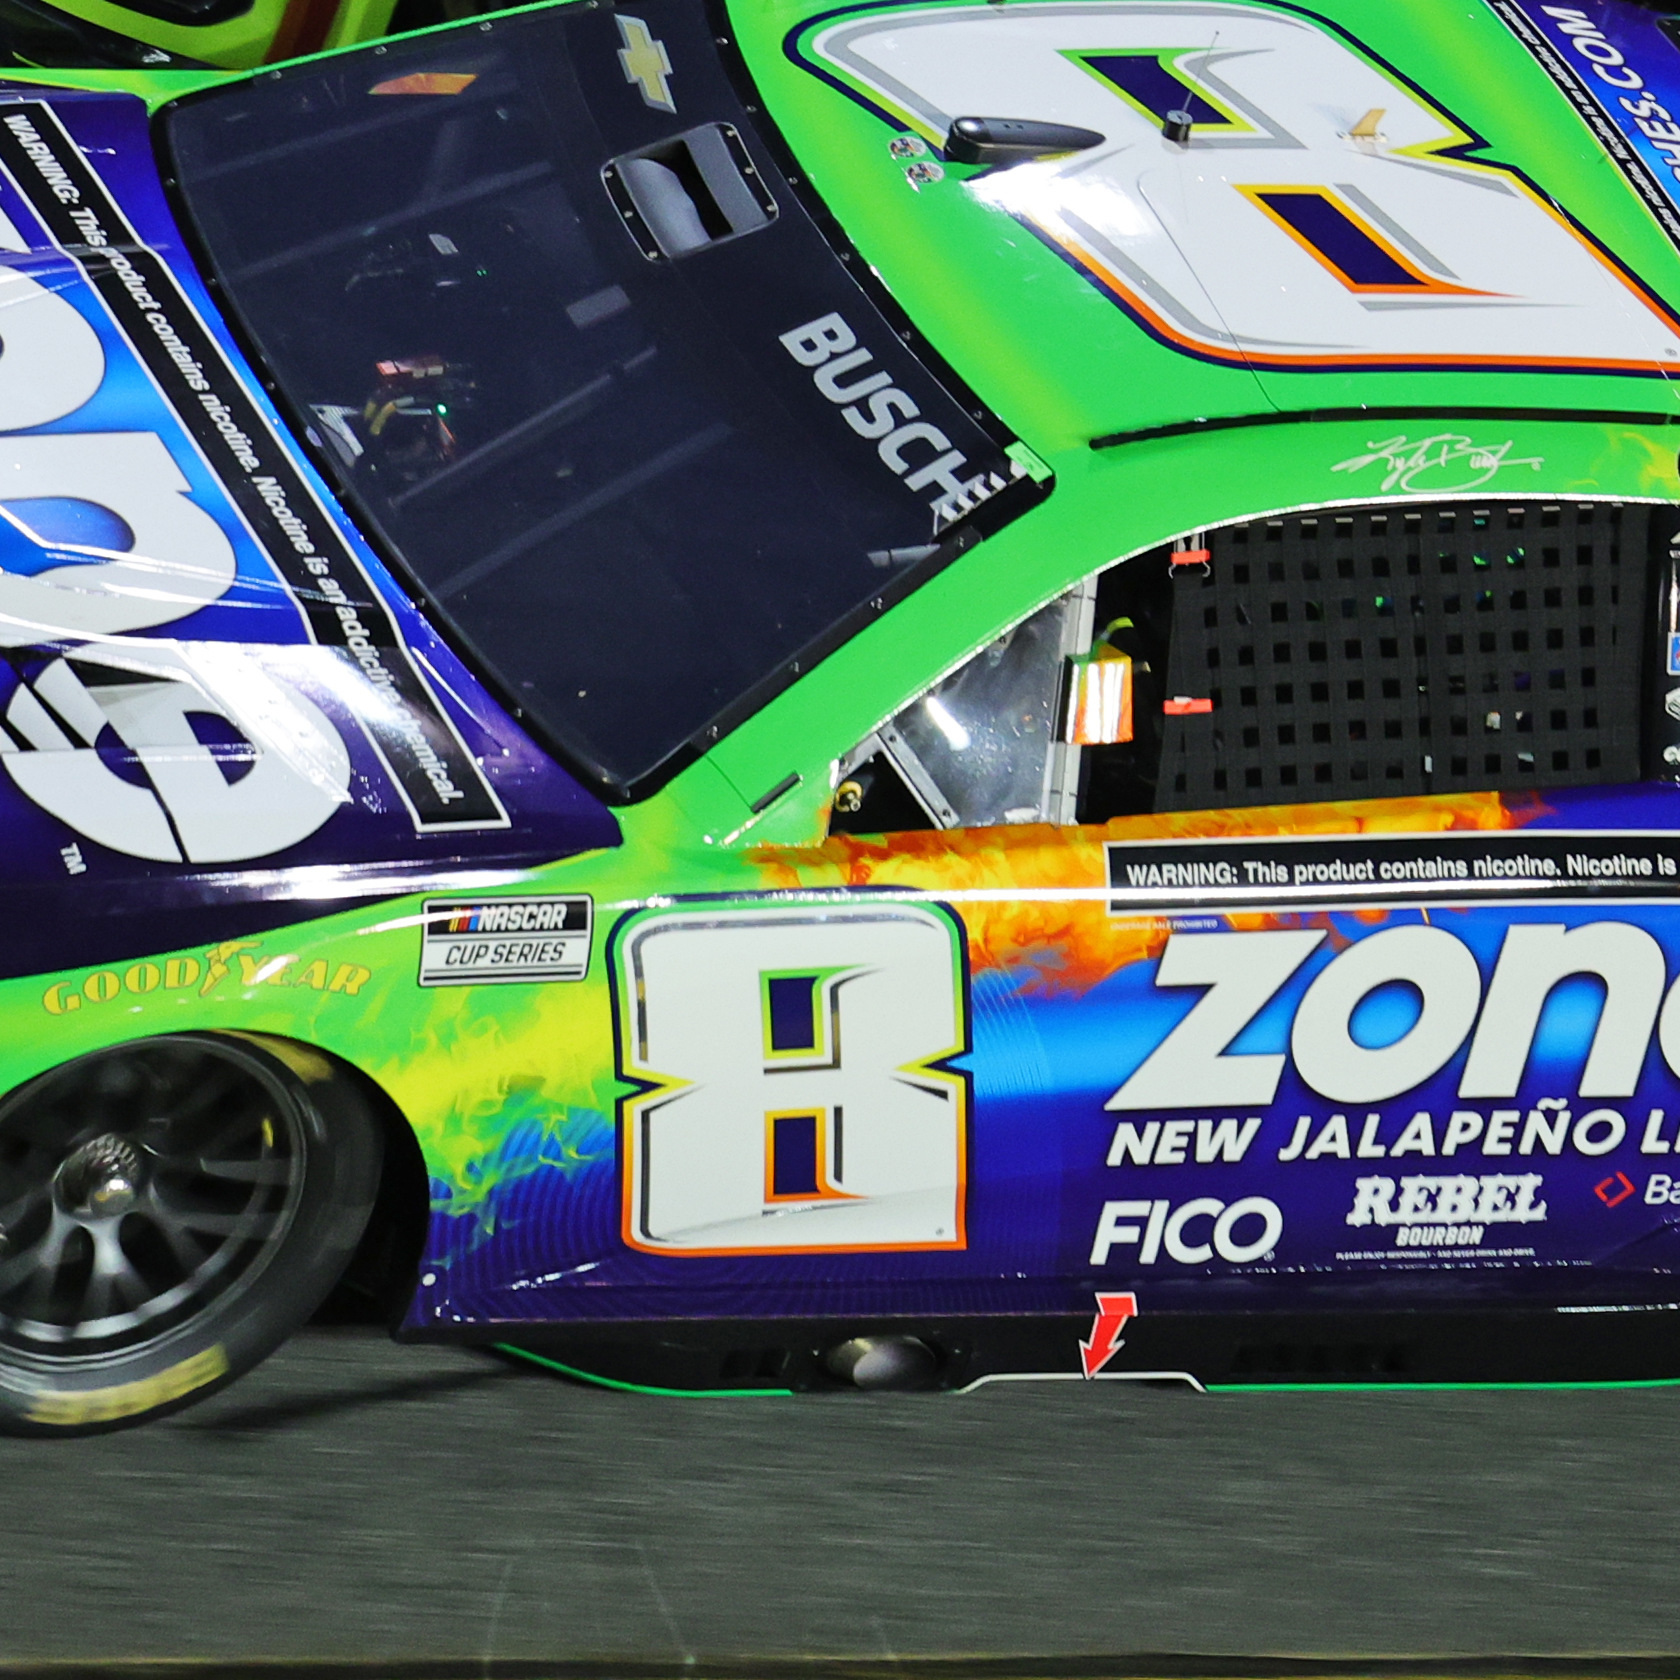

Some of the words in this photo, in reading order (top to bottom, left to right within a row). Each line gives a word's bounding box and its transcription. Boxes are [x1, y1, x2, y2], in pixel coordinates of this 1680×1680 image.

[3, 114, 81, 204] WARNING:
[70, 207, 107, 250] This
[91, 245, 161, 310] product
[146, 311, 210, 391] contains
[198, 392, 262, 473] nicotine.
[252, 475, 314, 554] Nicotine
[304, 556, 328, 577] is
[318, 577, 346, 604] an
[779, 311, 985, 520] BUSCH
[1127, 862, 1239, 886] WARNING:
[1243, 861, 1288, 883] This
[1294, 858, 1375, 885] product
[1380, 855, 1468, 880] contains
[1473, 853, 1561, 879] nicotine.
[1566, 853, 1653, 876] Nicotine
[1657, 853, 1677, 876] is
[476, 903, 567, 932] NASCAR
[41, 941, 370, 1017] GOODYEAR
[444, 944, 488, 968] CUP
[489, 941, 565, 965] SERIES
[606, 886, 973, 1257] 8
[1107, 1119, 1259, 1166] NEW
[1278, 1098, 1625, 1164] JALAPEÑO
[1089, 1197, 1284, 1266] FICO
[1346, 1172, 1548, 1227] REBEL
[1395, 1225, 1485, 1246] BOURBON
